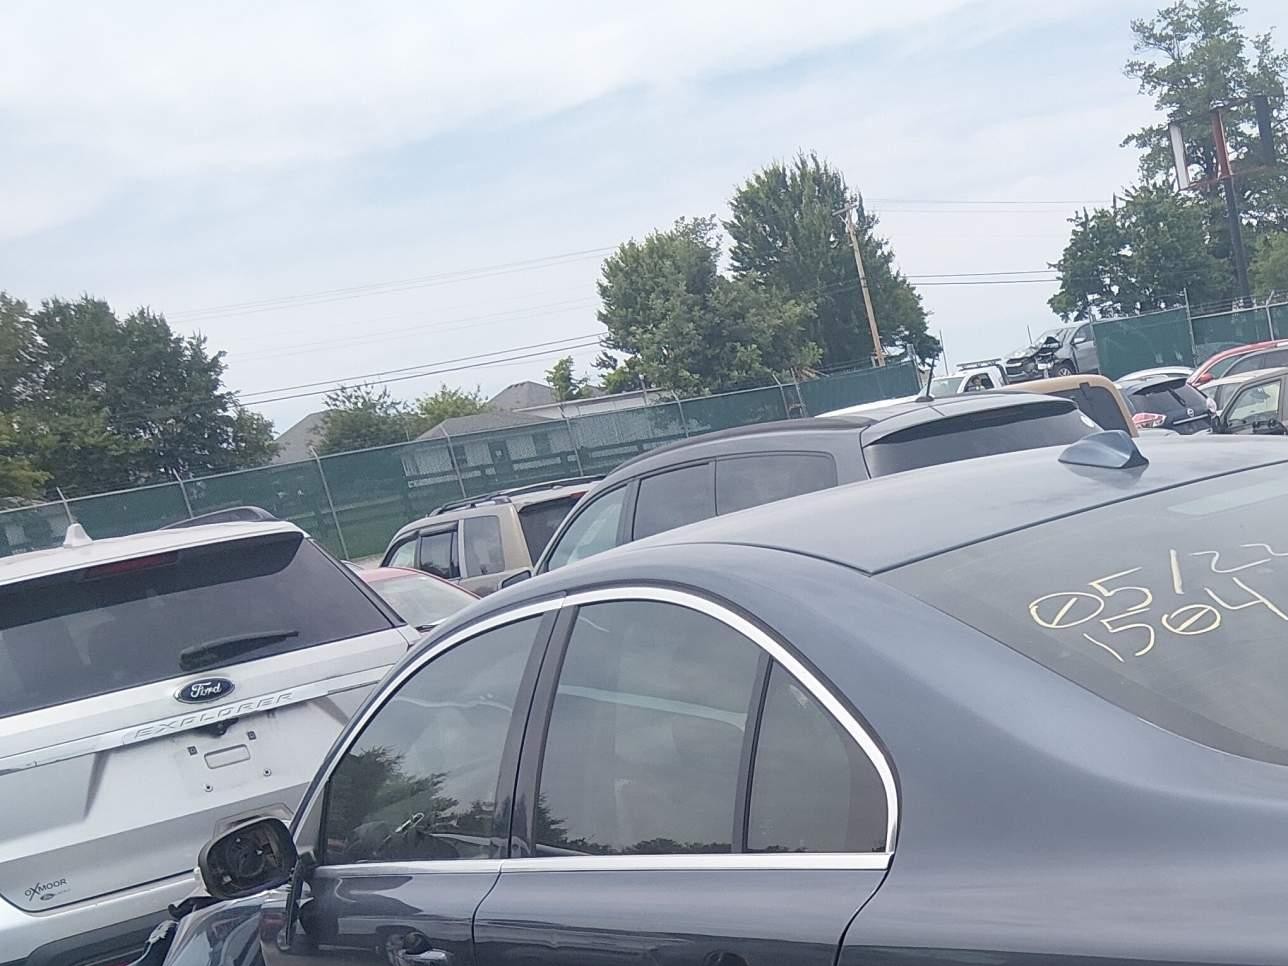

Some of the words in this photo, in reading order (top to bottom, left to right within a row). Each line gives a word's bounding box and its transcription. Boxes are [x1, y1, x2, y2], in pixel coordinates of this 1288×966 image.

[1083, 577, 1288, 663] 1504
[189, 681, 223, 698] Ford
[135, 692, 293, 739] EXPLORER
[24, 878, 67, 902] OXMOOR
